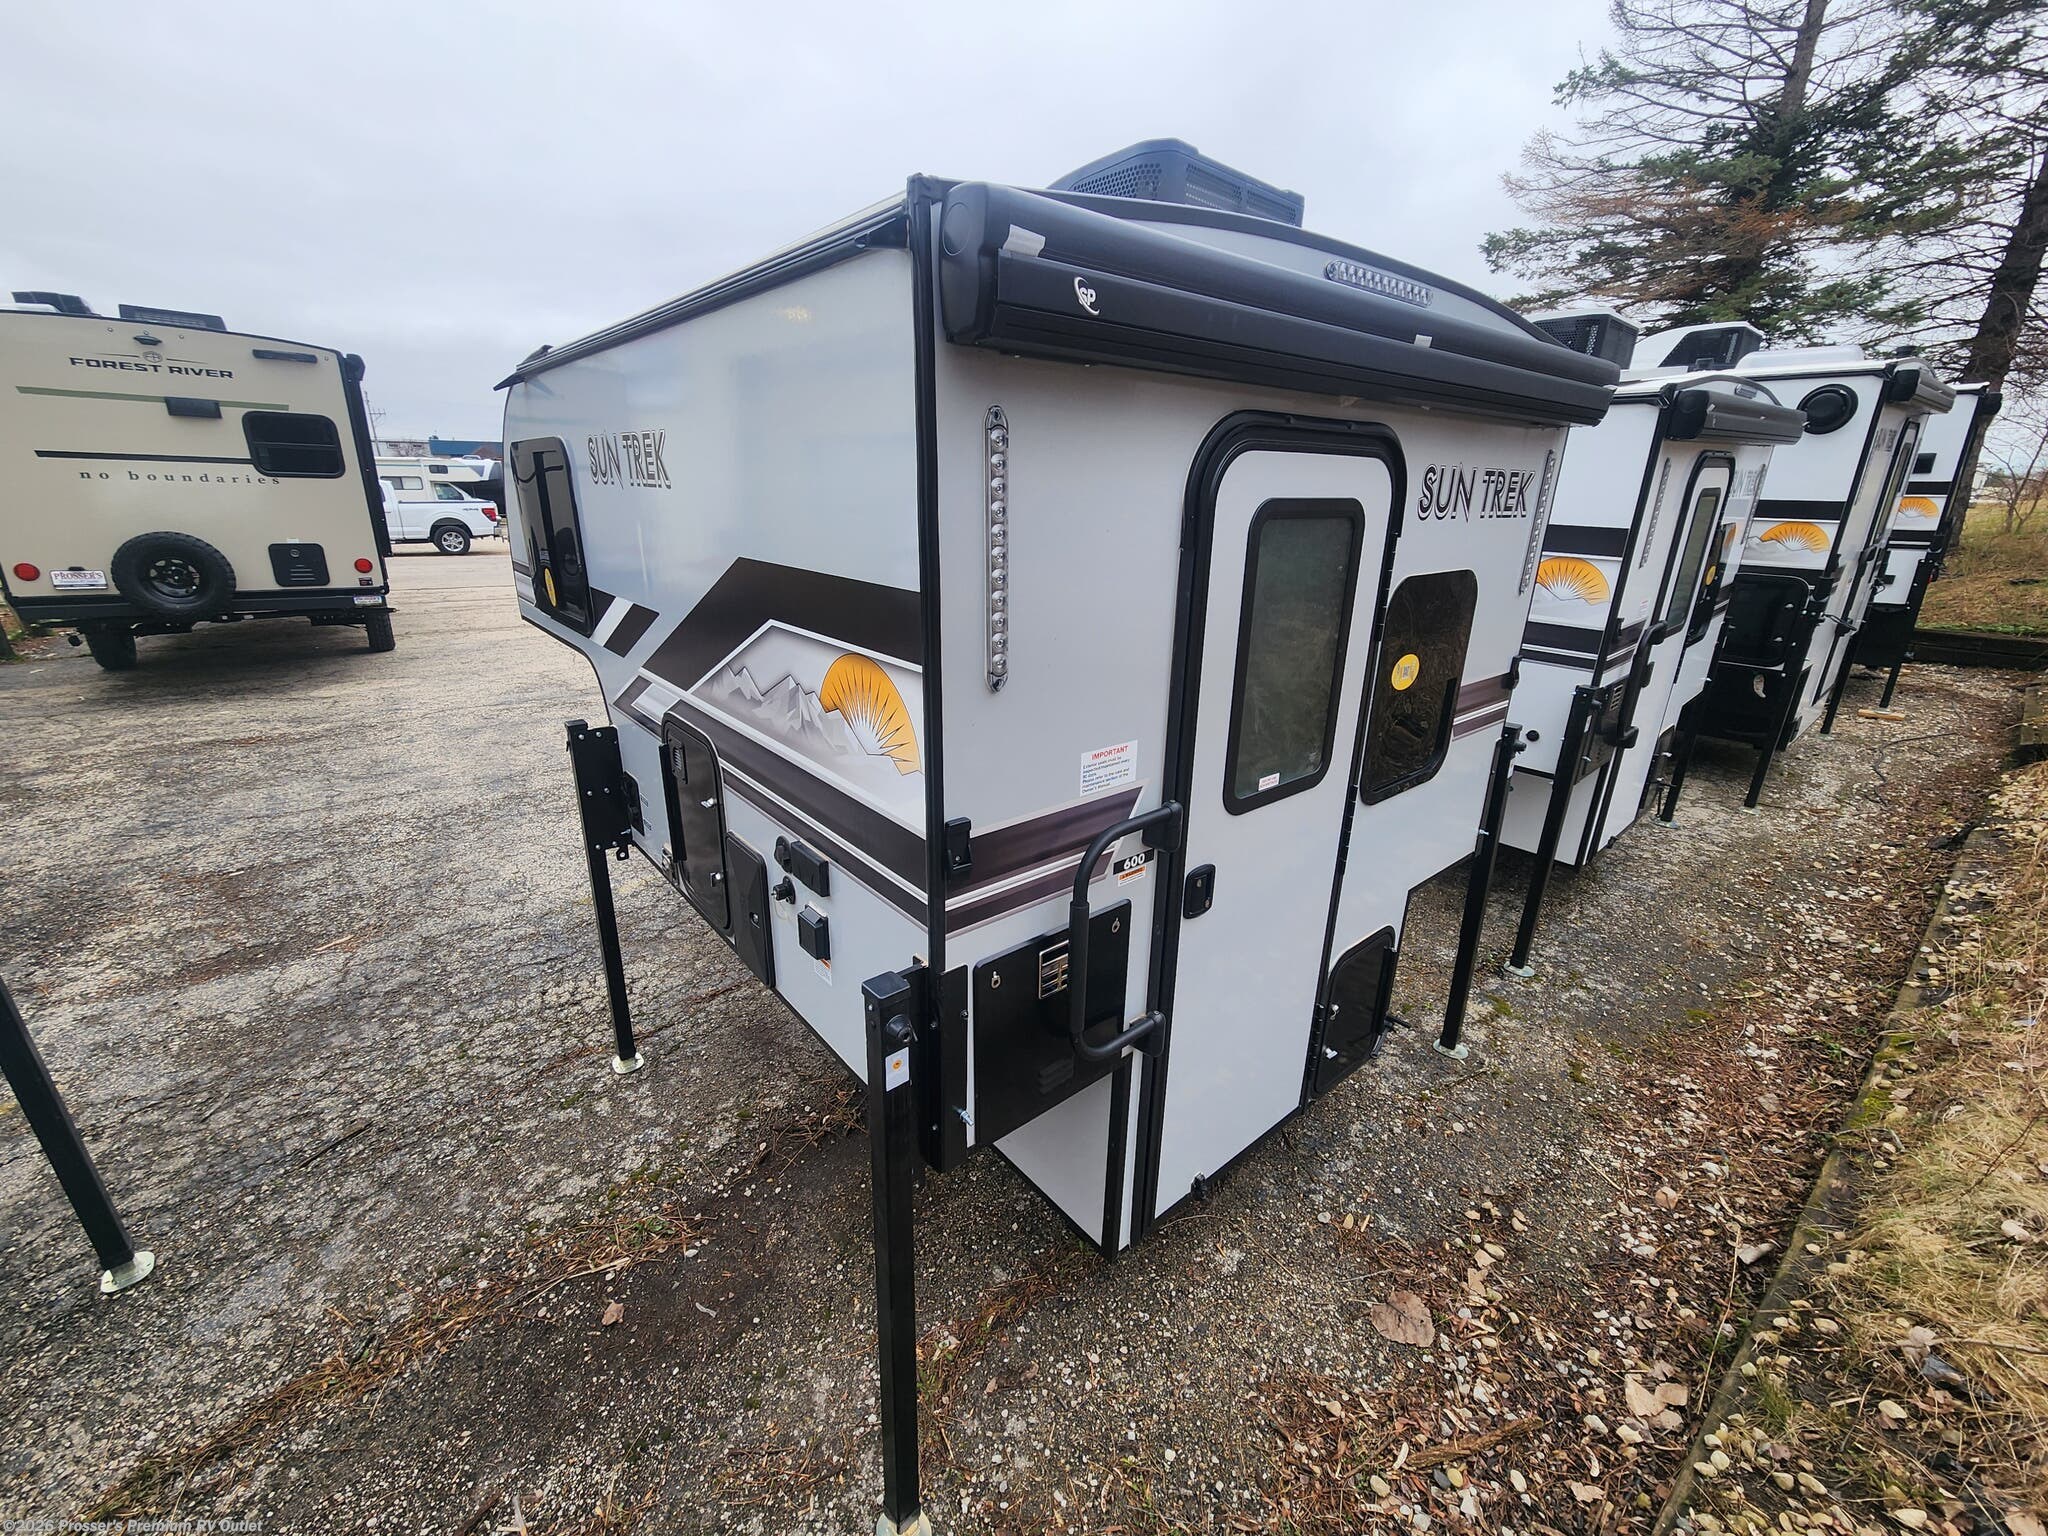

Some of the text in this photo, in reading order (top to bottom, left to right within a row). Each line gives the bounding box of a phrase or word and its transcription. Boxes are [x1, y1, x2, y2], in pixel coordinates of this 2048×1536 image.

[69, 357, 234, 379] FOREST RIVER
[587, 429, 672, 490] SUN TREK
[79, 471, 280, 485] no boundaries
[1417, 462, 1536, 523] SUN TREK
[1091, 745, 1128, 761] IMPORTANT
[1124, 853, 1145, 870] 600
